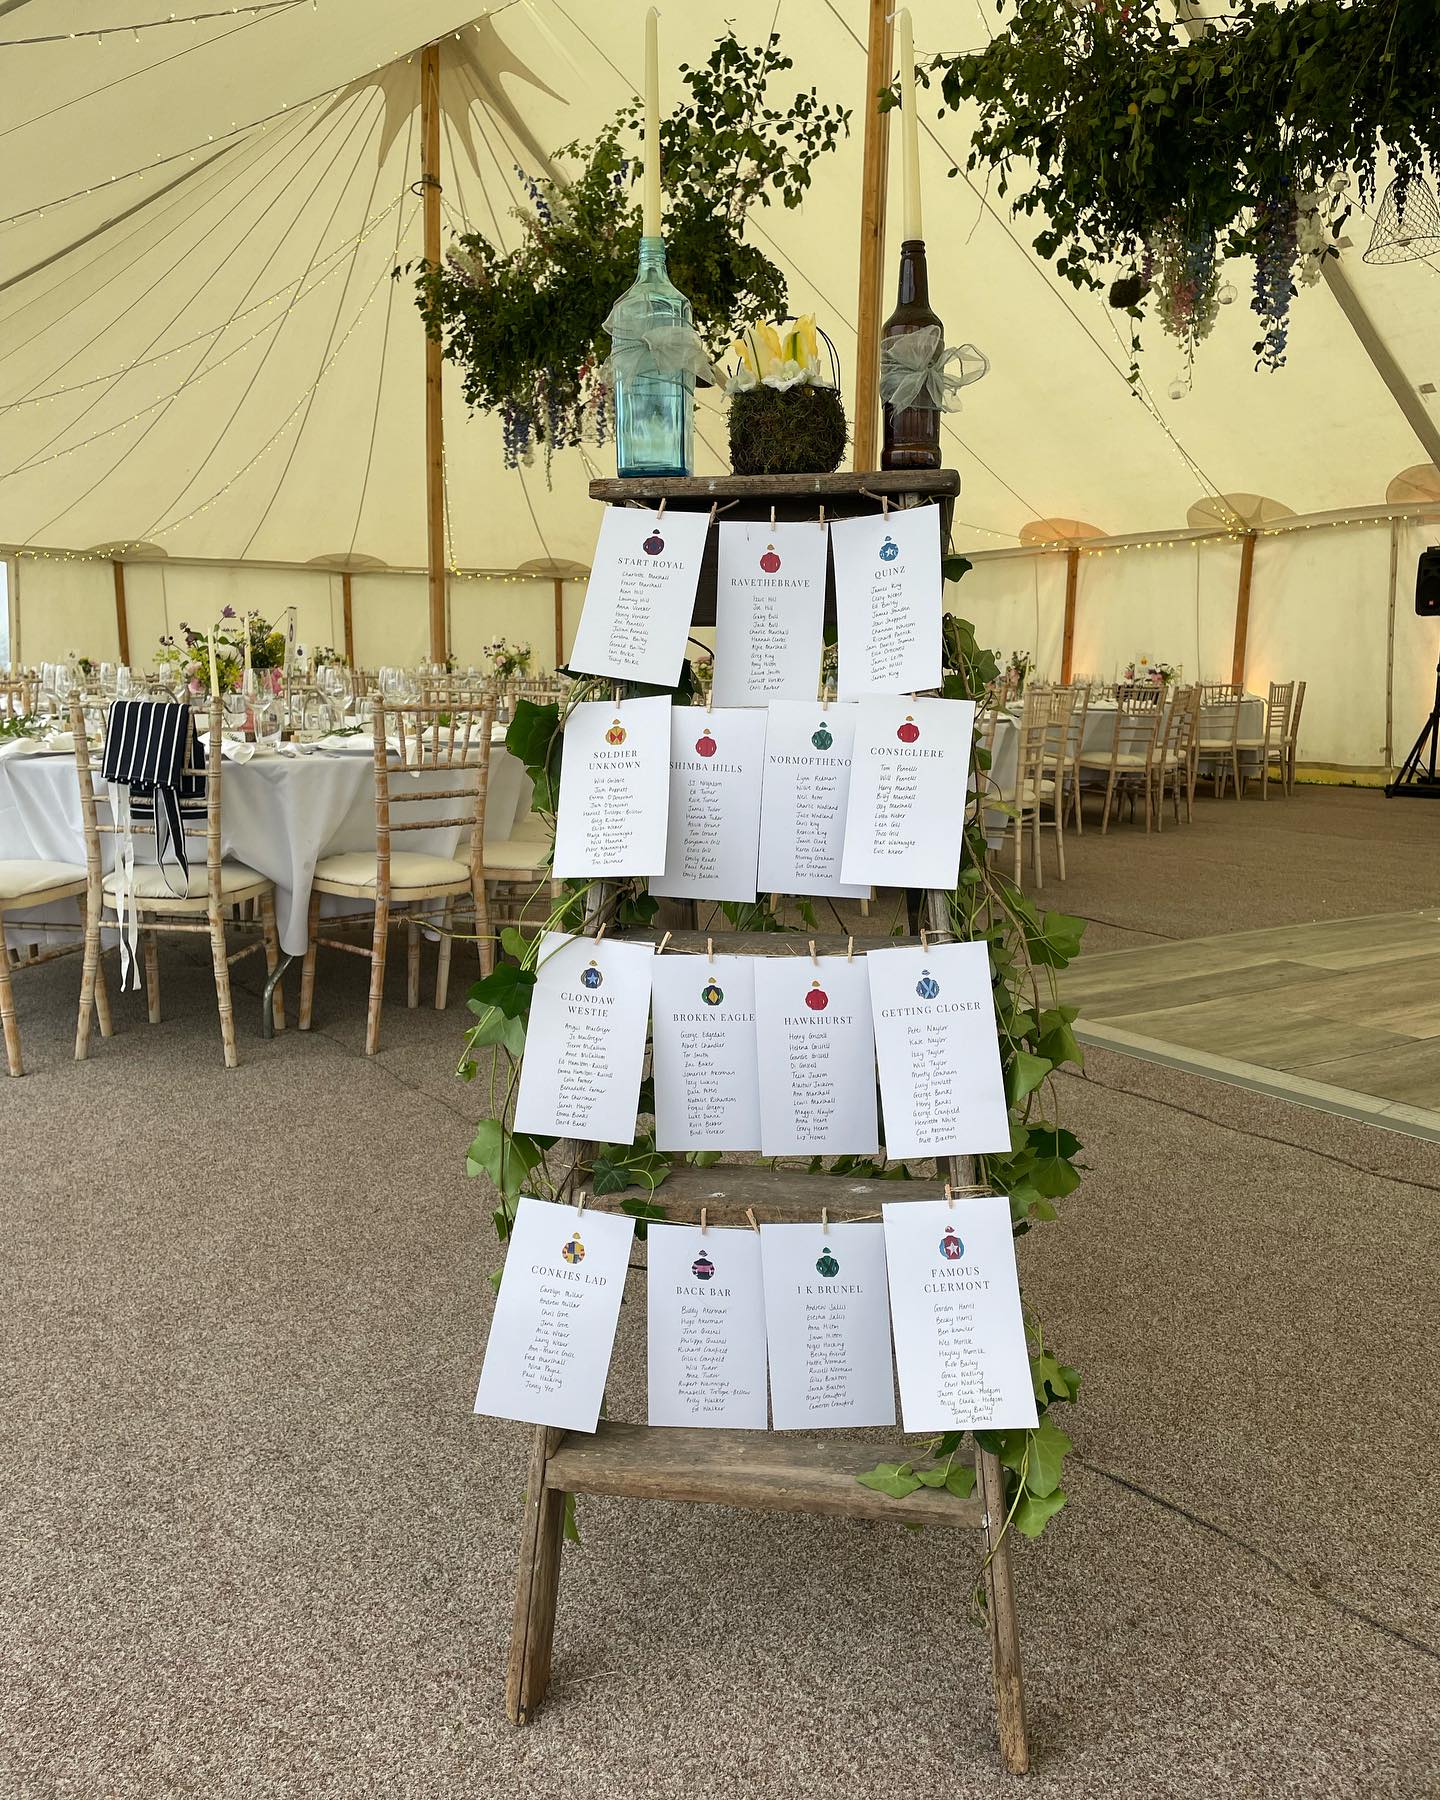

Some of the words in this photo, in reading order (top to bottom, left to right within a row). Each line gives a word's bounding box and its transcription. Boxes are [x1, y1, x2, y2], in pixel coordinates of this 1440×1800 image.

[617, 557, 650, 567] START
[652, 560, 685, 570] ROYAL
[874, 565, 906, 580] QUINZ
[731, 578, 810, 588] RAVETHEBRAVE
[593, 750, 637, 759] SOLDIER
[870, 747, 944, 758] CONSIGLIERE
[589, 760, 641, 770] UNKNOWN
[669, 761, 708, 771] SHIMBA
[712, 763, 743, 773] HILLS
[560, 992, 615, 1005] CLONDAW
[568, 1005, 609, 1018] WESTIE
[881, 1005, 932, 1018] GETTING
[936, 1001, 981, 1013] CLOSER
[673, 1013, 716, 1022] BROKEN
[720, 1013, 756, 1022] EAGLE
[784, 1015, 853, 1026] HAWKHURST
[531, 1265, 581, 1282] CONKIES
[585, 1274, 607, 1286] LAD
[931, 1266, 980, 1278] FAMOUS
[676, 1286, 705, 1296] BACK
[710, 1288, 731, 1297] BAR
[806, 1285, 813, 1295] K
[817, 1285, 863, 1294] BRUNEL
[924, 1280, 990, 1294] CLERMONT
